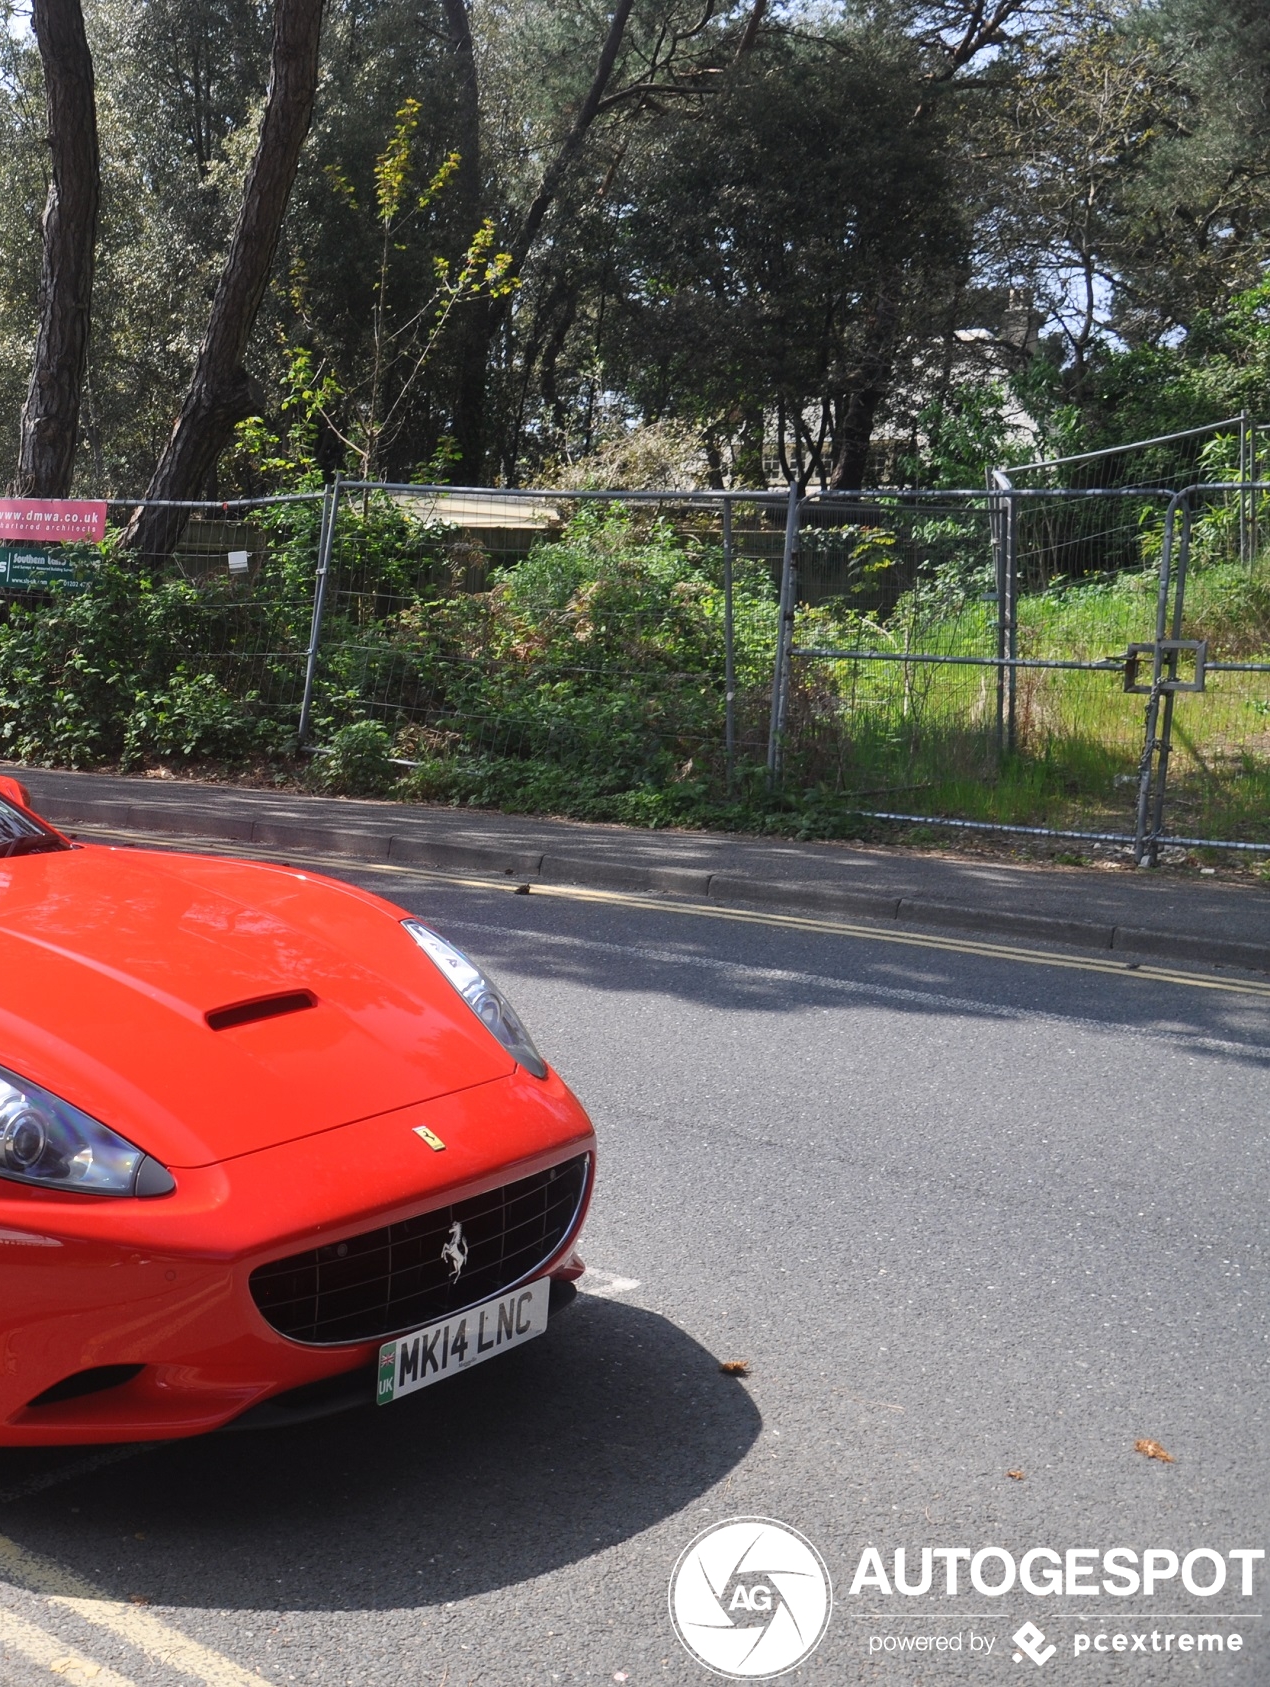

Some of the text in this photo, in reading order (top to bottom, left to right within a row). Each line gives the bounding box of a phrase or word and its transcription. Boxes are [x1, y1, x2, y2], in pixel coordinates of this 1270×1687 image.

[46, 524, 97, 533] architects
[13, 553, 45, 565] Southern
[63, 579, 79, 588] 01202
[398, 1291, 533, 1388] MK14 LNC
[379, 1377, 393, 1394] UK
